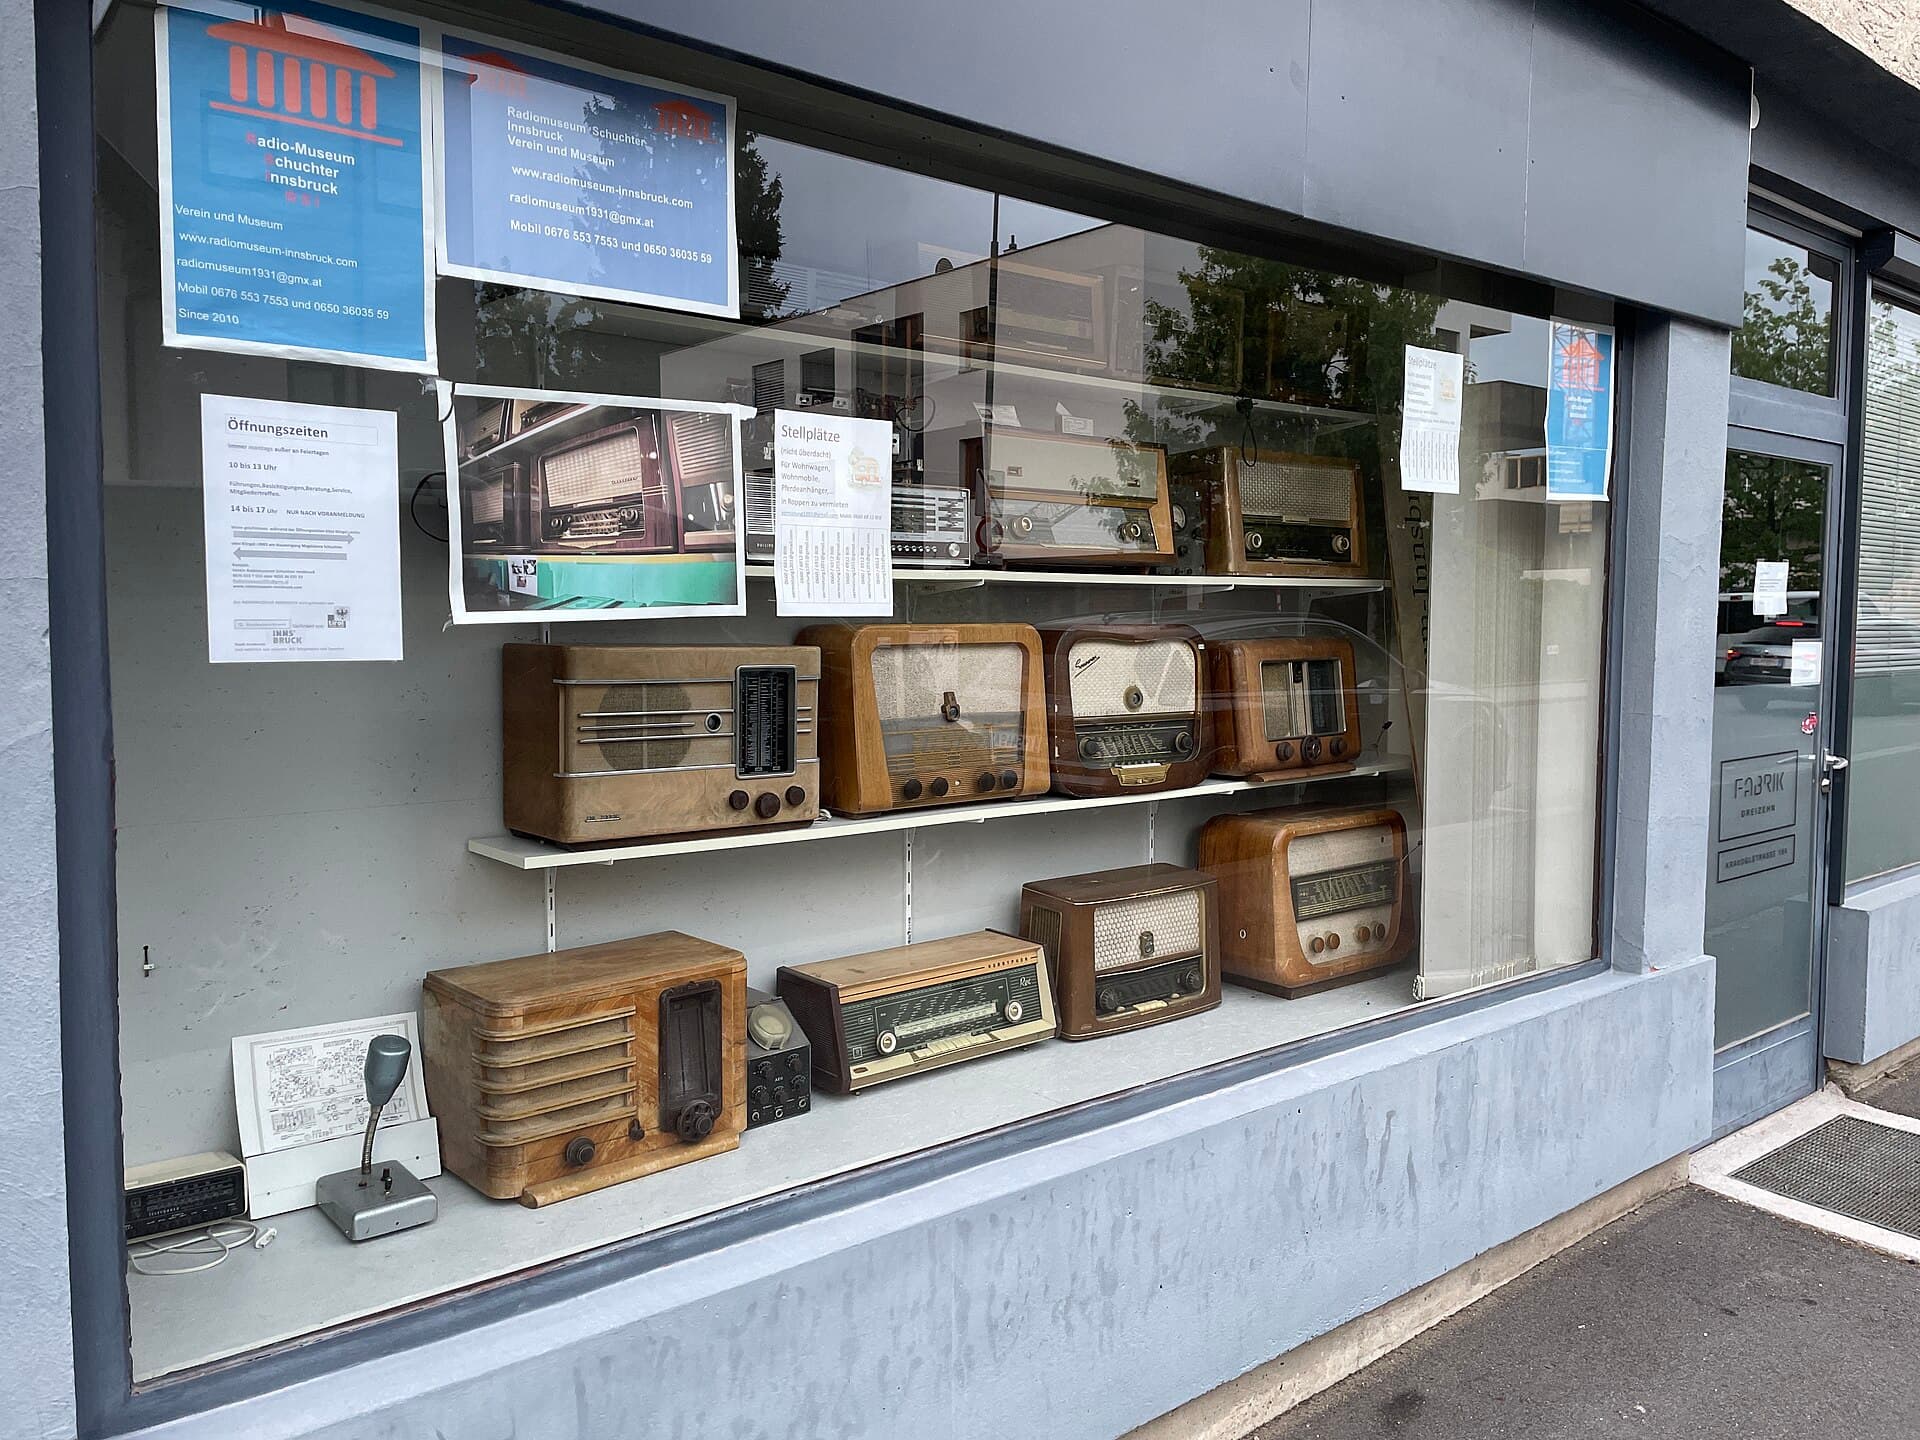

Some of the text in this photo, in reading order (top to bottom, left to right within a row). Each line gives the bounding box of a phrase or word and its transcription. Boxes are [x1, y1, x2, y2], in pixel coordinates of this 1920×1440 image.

[507, 106, 647, 147] Radiomuseum Schuchter
[507, 121, 564, 142] Innsbruck
[507, 135, 615, 168] Verein und Museum
[265, 169, 339, 196] Innsbruck
[512, 165, 693, 209] www.radiomuseum-innsbruck.com
[175, 203, 284, 231] Verein und Museum
[509, 193, 655, 228] radiomuseum1931@gmx.at
[179, 231, 358, 268] www.radiomuseum-innsbruck.com
[510, 219, 713, 264] Mobil 0676 553 7553 und 0650 36035 59
[176, 257, 323, 288] radiomuseum1931@gmx.at
[177, 281, 390, 320] Mobil 0676 553 7553 und 0650 36035 59
[178, 308, 240, 325] Since 2010
[228, 416, 329, 439] Öffnungszeiten
[781, 424, 841, 443] Stellplätze
[300, 448, 329, 457] Feiertagen
[781, 447, 832, 459] (nicht überdacht)
[229, 461, 278, 472] 10 bis 13 Uhr
[781, 460, 831, 473] Für Wohnwagen,
[231, 504, 241, 512] 14
[242, 505, 254, 513] bis
[256, 506, 266, 514] 17
[300, 509, 317, 517] NACH
[819, 501, 849, 509] vermieten
[1734, 771, 1785, 799] FABRIK
[1741, 804, 1776, 818] DREIZEHN
